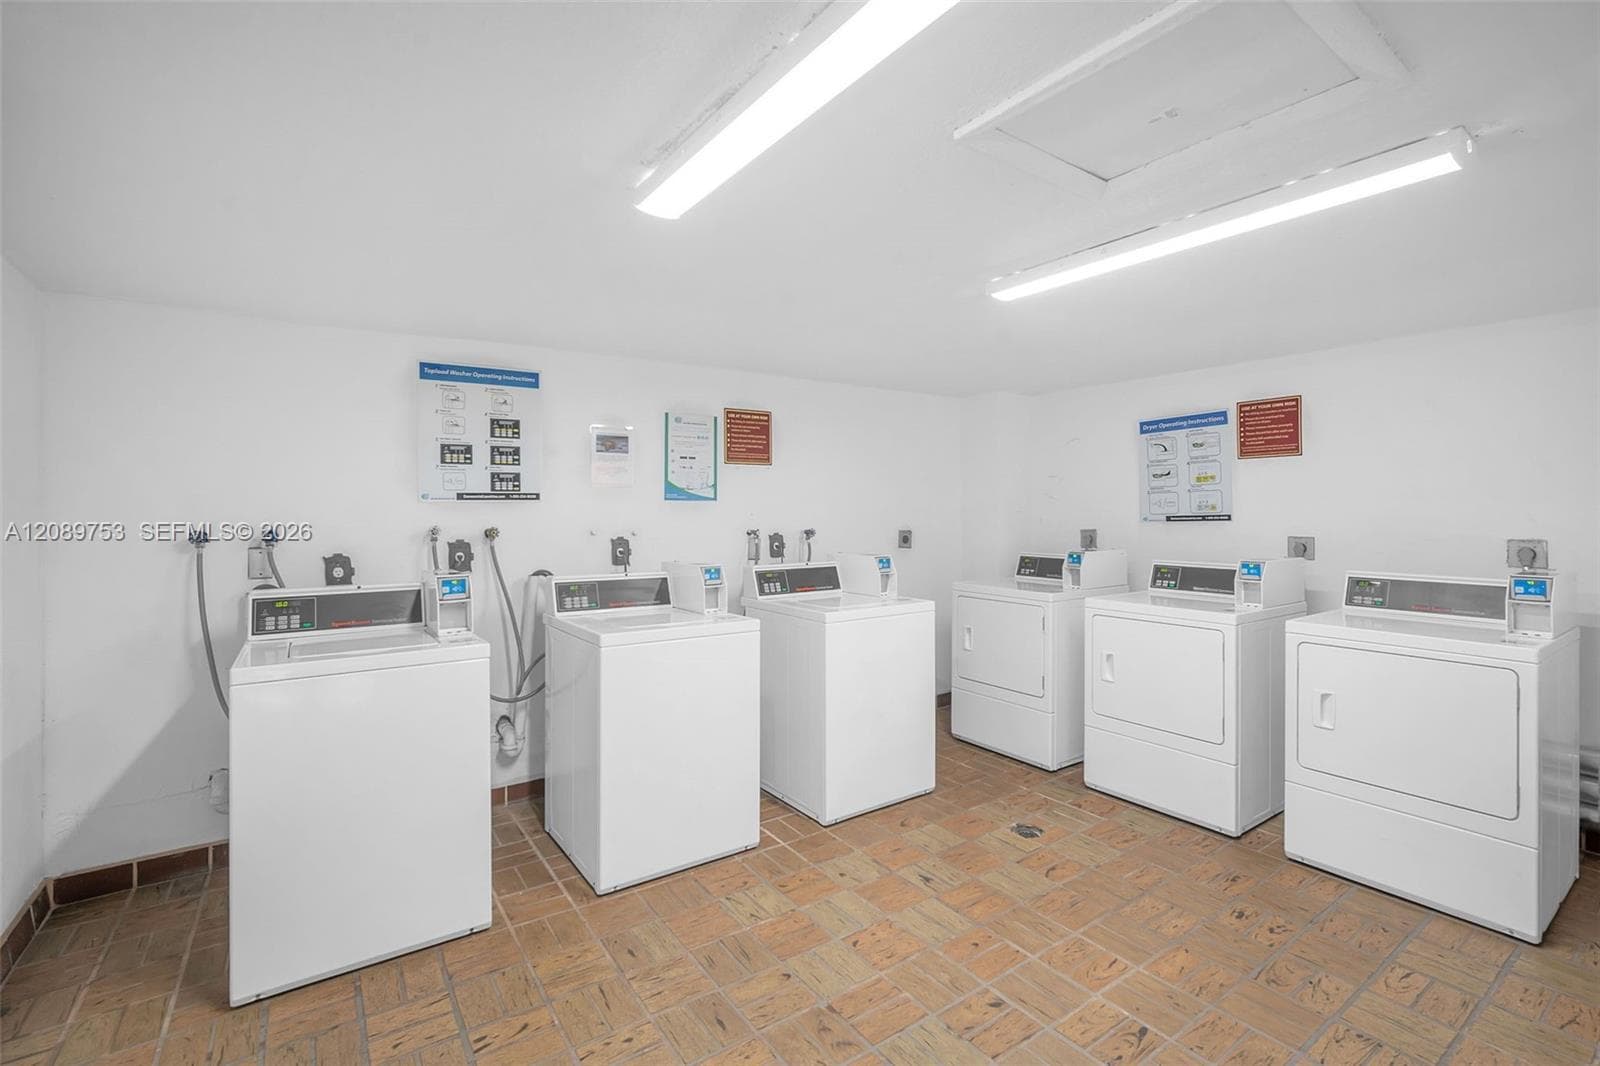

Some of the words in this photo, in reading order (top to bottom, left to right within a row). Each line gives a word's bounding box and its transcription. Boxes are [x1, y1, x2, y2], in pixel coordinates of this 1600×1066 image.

[424, 367, 449, 377] Topload
[450, 370, 472, 378] Washer
[472, 371, 502, 381] Operating
[503, 374, 535, 382] Instructions
[1142, 423, 1158, 431] Dryer
[1159, 419, 1187, 429] Operating
[1188, 415, 1225, 425] Instructions
